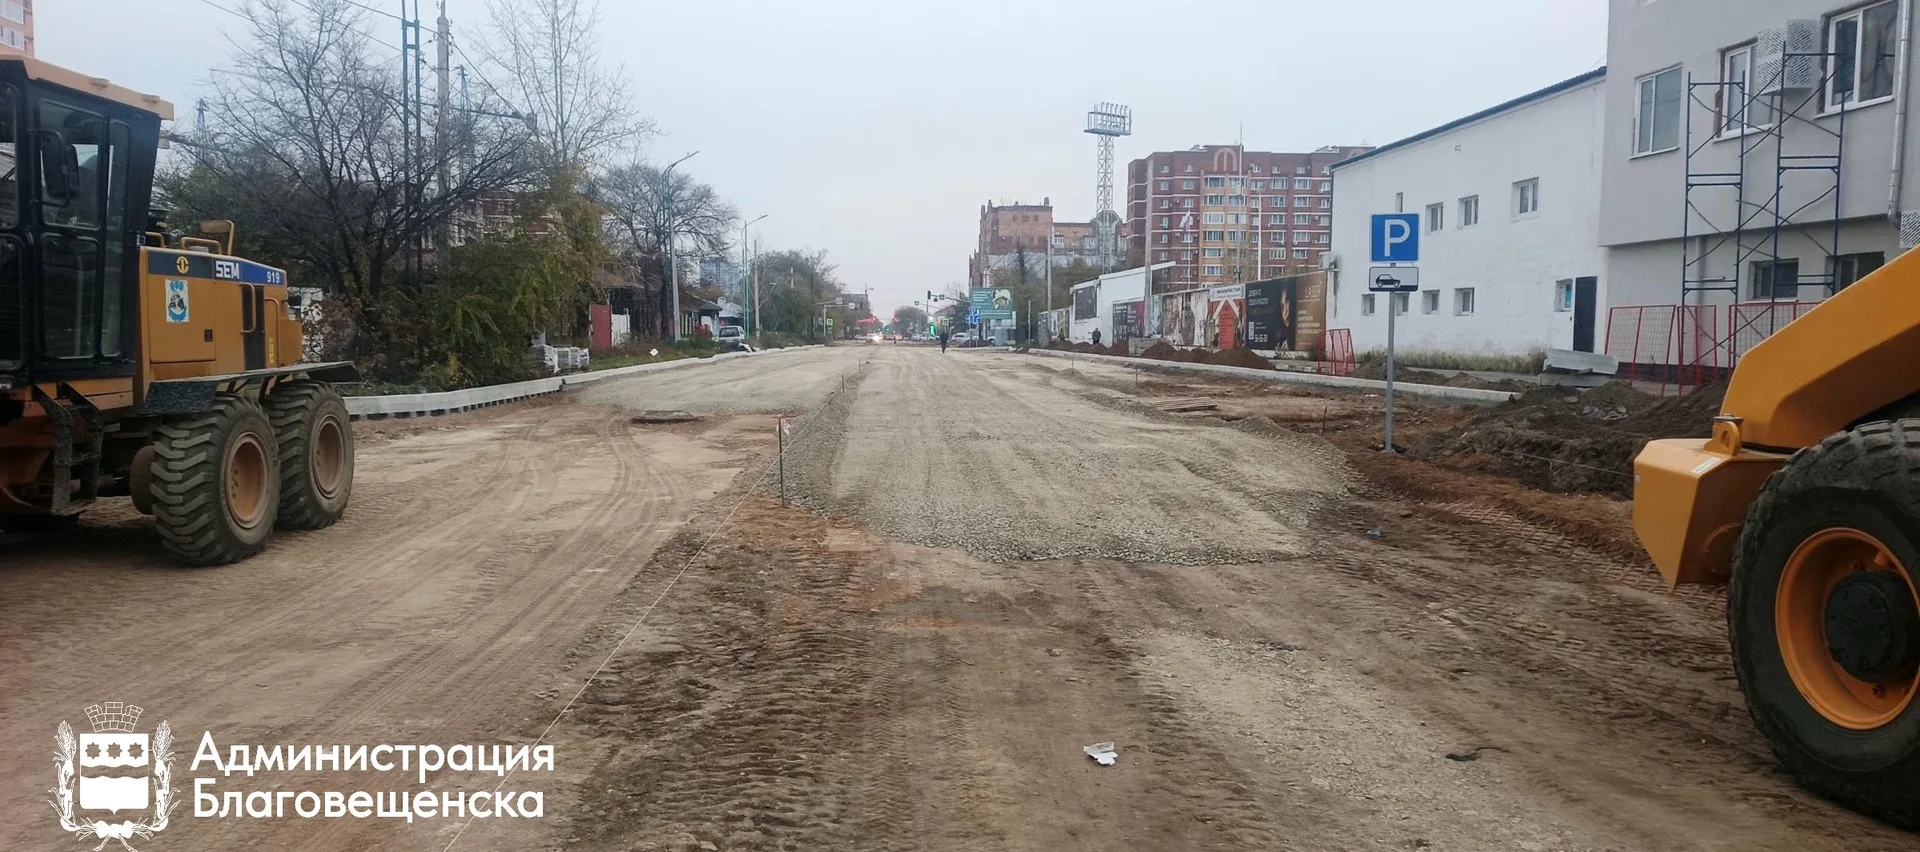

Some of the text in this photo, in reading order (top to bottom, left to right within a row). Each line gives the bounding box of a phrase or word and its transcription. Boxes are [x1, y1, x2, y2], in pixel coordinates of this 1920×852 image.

[1384, 219, 1411, 257] P
[215, 260, 240, 279] SEM
[266, 271, 280, 283] 919
